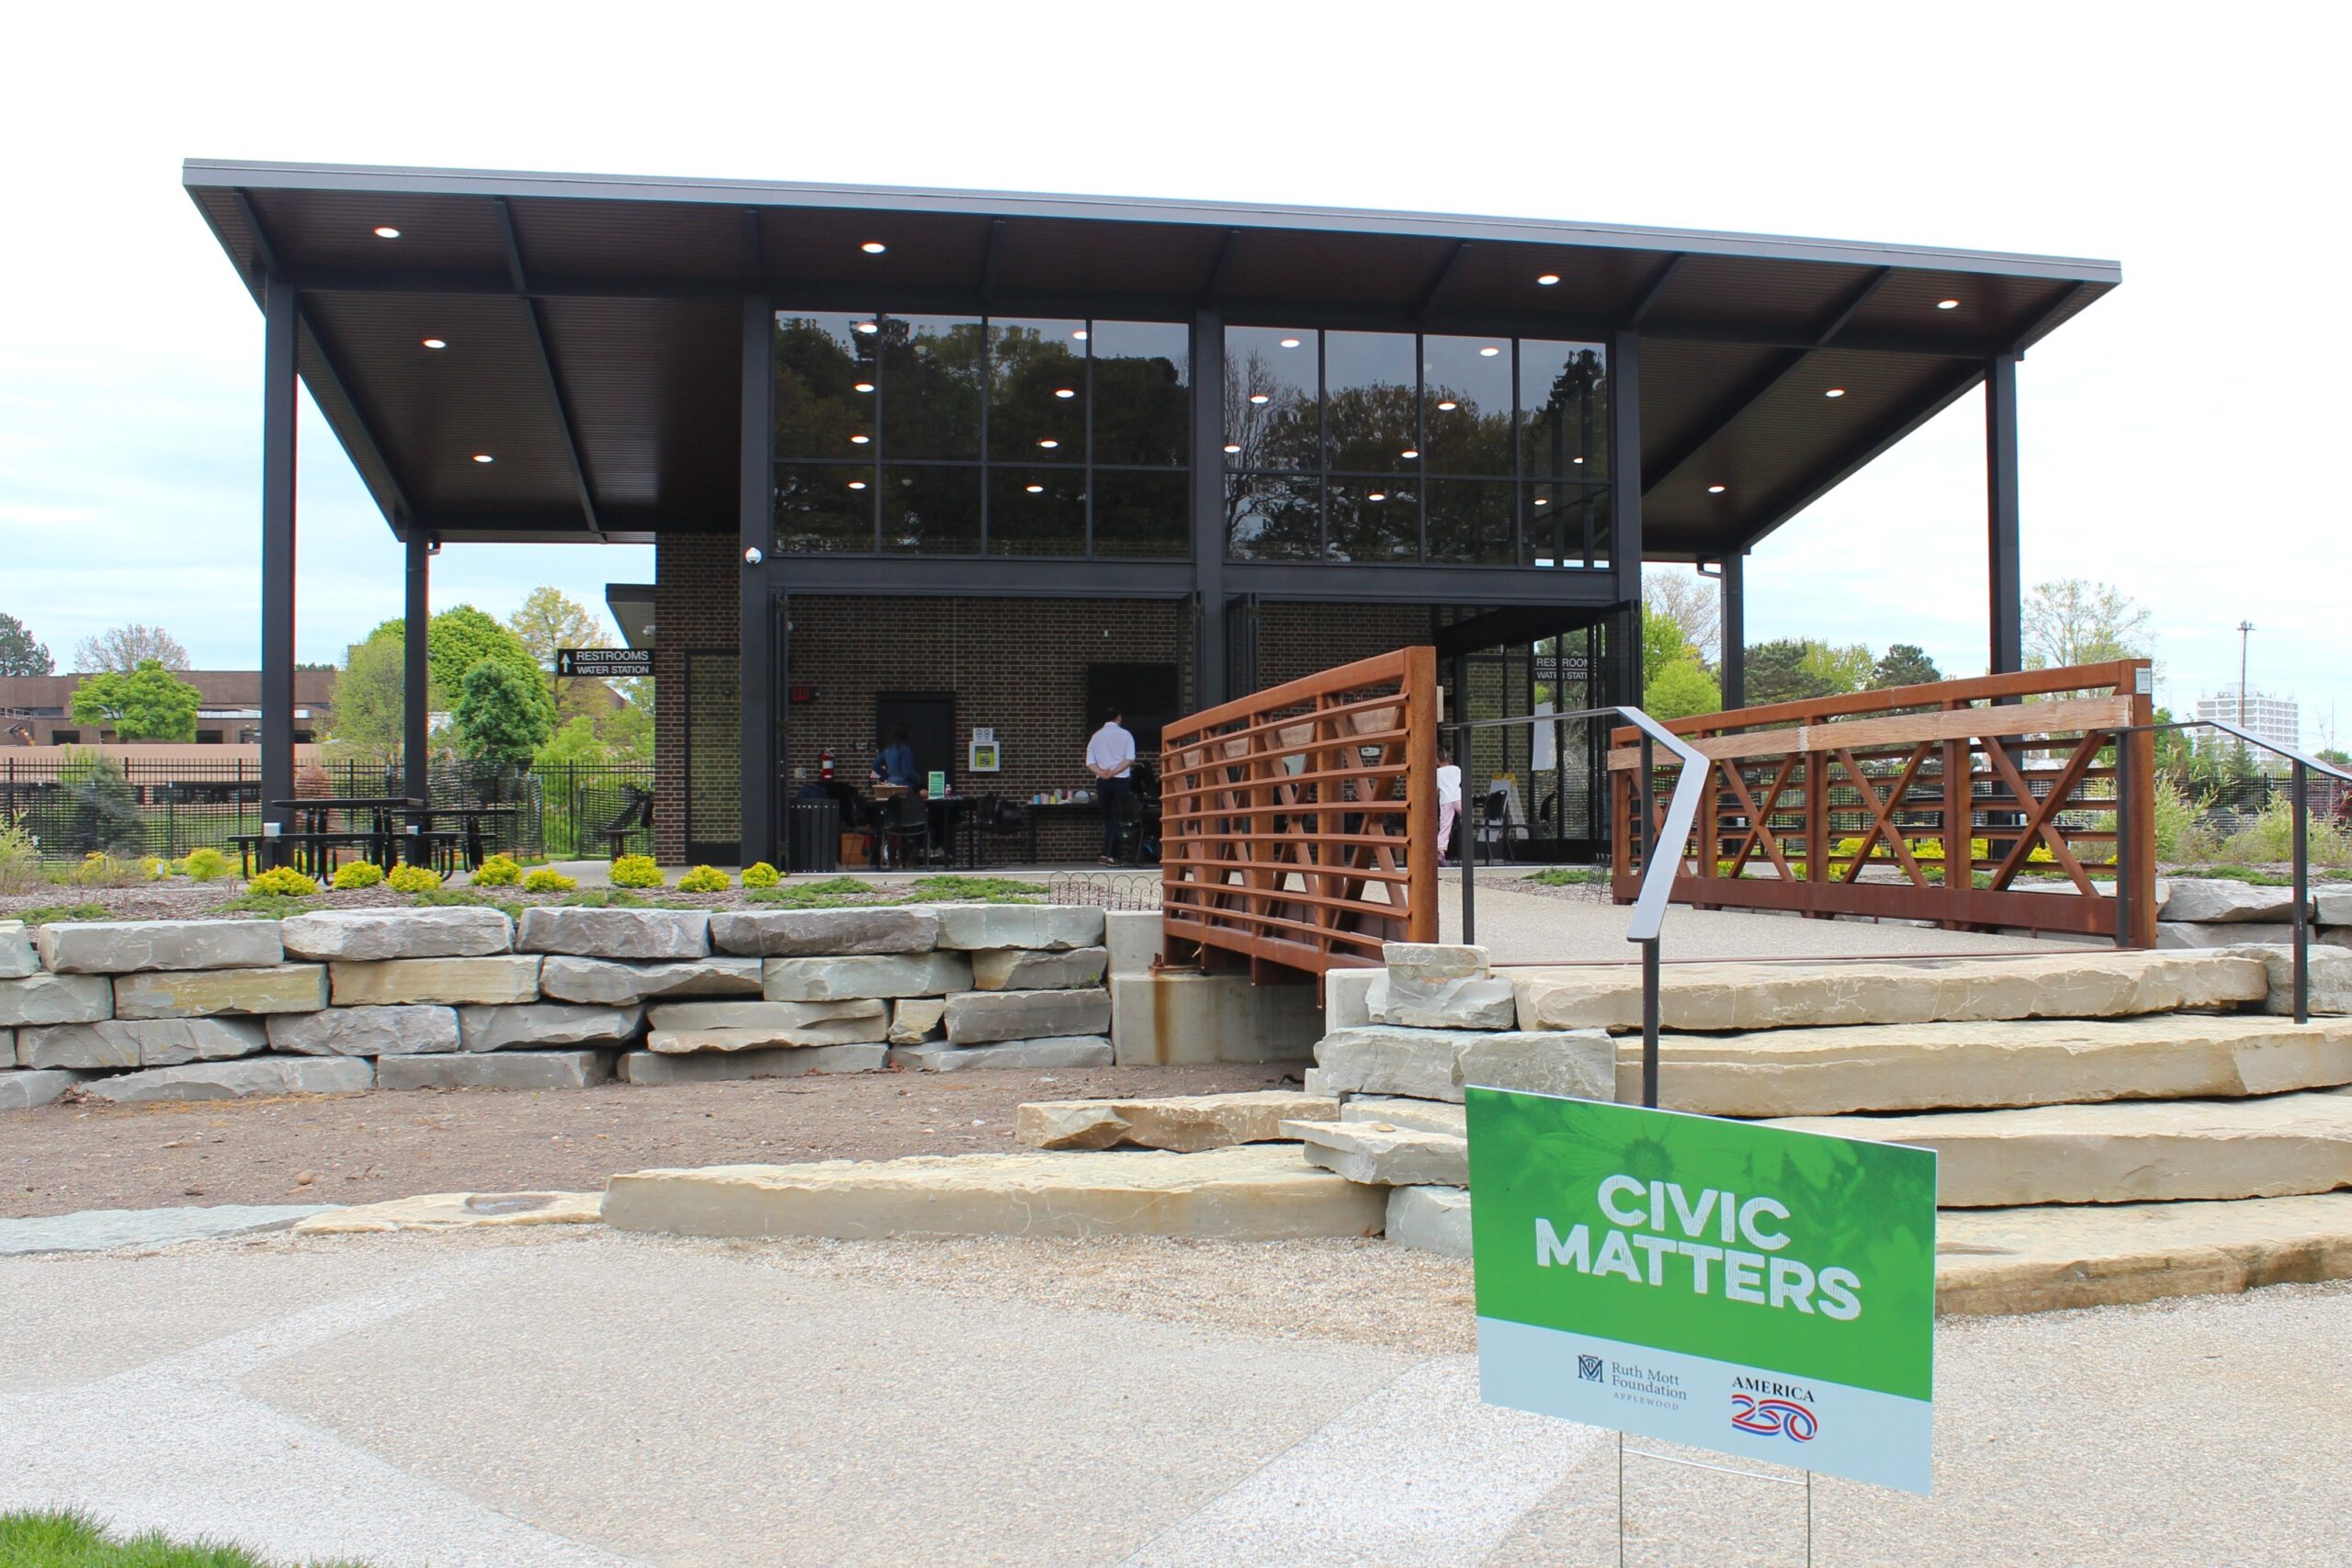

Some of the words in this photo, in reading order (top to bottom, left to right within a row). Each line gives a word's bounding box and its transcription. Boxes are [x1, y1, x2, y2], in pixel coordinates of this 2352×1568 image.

[576, 650, 649, 660] RESTROOMS
[577, 665, 609, 674] WATER
[611, 665, 650, 674] STATION
[1598, 1174, 1791, 1250] CIVIC
[1535, 1218, 1861, 1320] MATTERS
[1611, 1361, 1643, 1378] Ruth
[1647, 1369, 1680, 1385] Mott
[1611, 1374, 1688, 1400] Foundation
[1732, 1376, 1815, 1403] AMERICA
[1613, 1392, 1679, 1410] APPLEWOOD
[1732, 1393, 1817, 1443] 250
